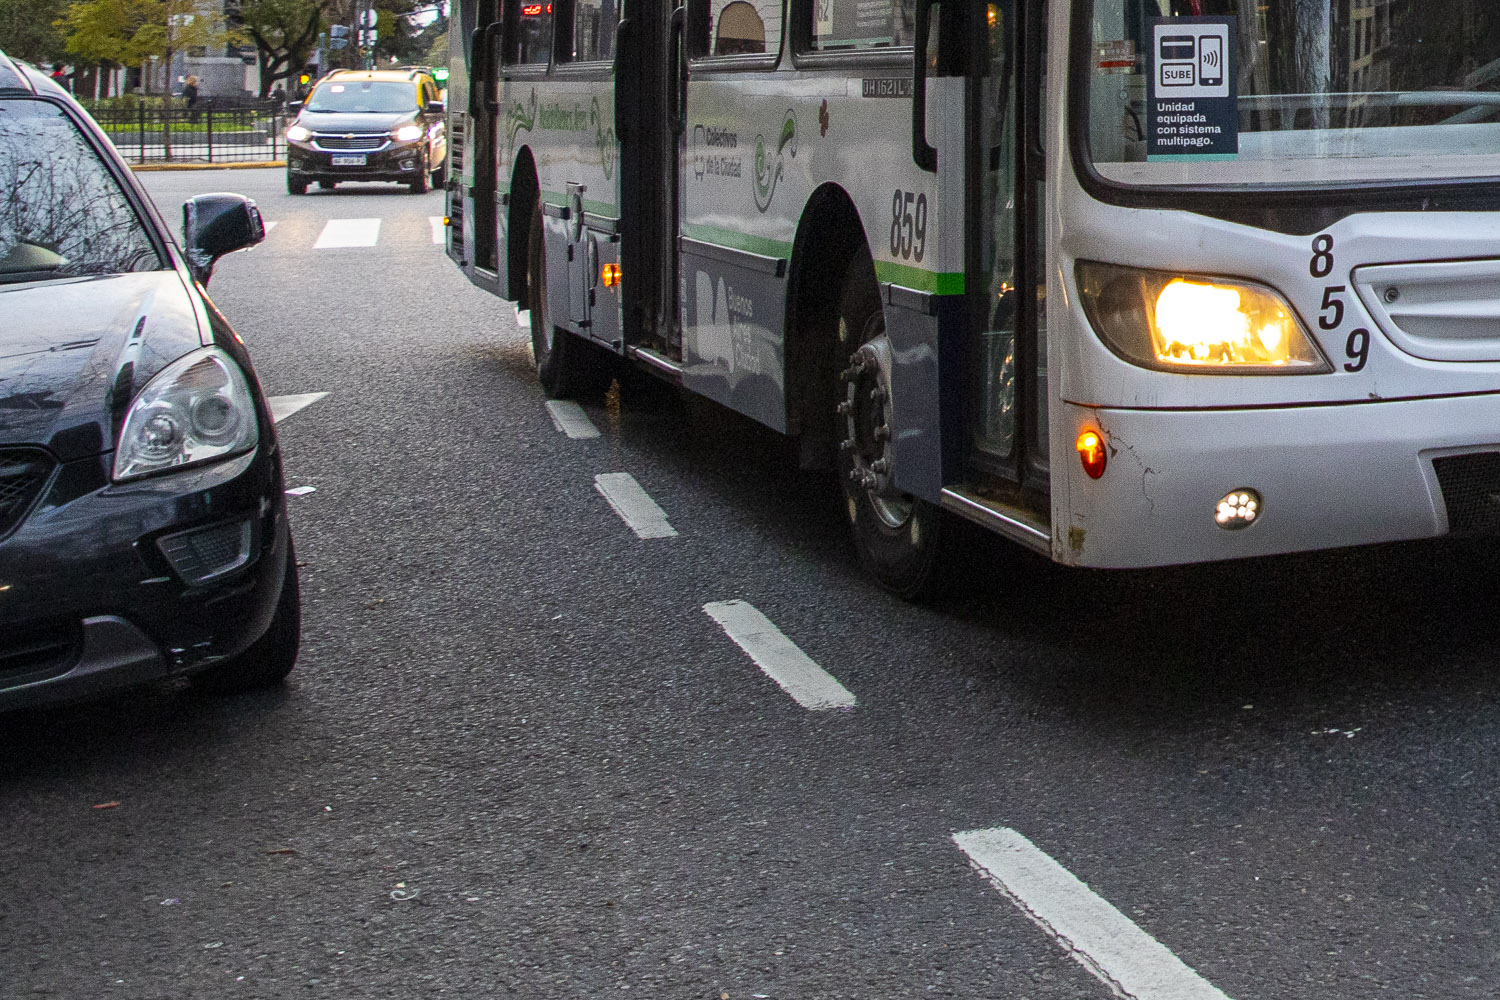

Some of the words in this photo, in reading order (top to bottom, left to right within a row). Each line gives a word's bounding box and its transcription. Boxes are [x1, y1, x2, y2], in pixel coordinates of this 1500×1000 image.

[1164, 70, 1192, 80] SUBE
[1157, 102, 1195, 112] Unidad
[1157, 113, 1207, 124] equipada
[1157, 126, 1177, 134] con
[1179, 124, 1222, 134] sistema
[1157, 136, 1214, 147] multipago.
[890, 188, 928, 263] 859
